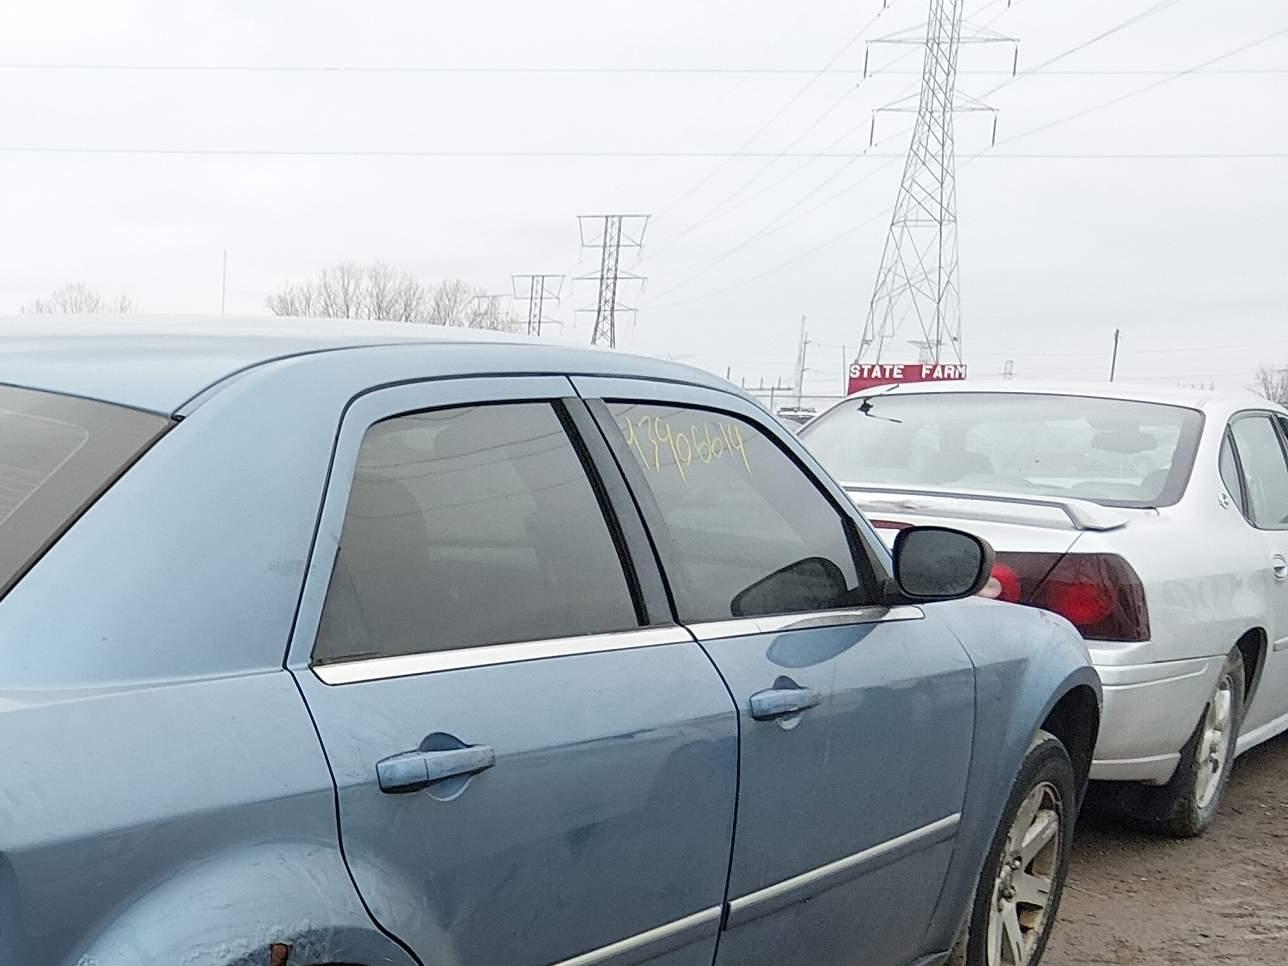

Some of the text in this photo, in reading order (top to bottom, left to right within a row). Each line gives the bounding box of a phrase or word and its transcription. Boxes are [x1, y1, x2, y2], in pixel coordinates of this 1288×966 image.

[850, 364, 966, 379] STATE FARM
[625, 415, 752, 482] 43906614
